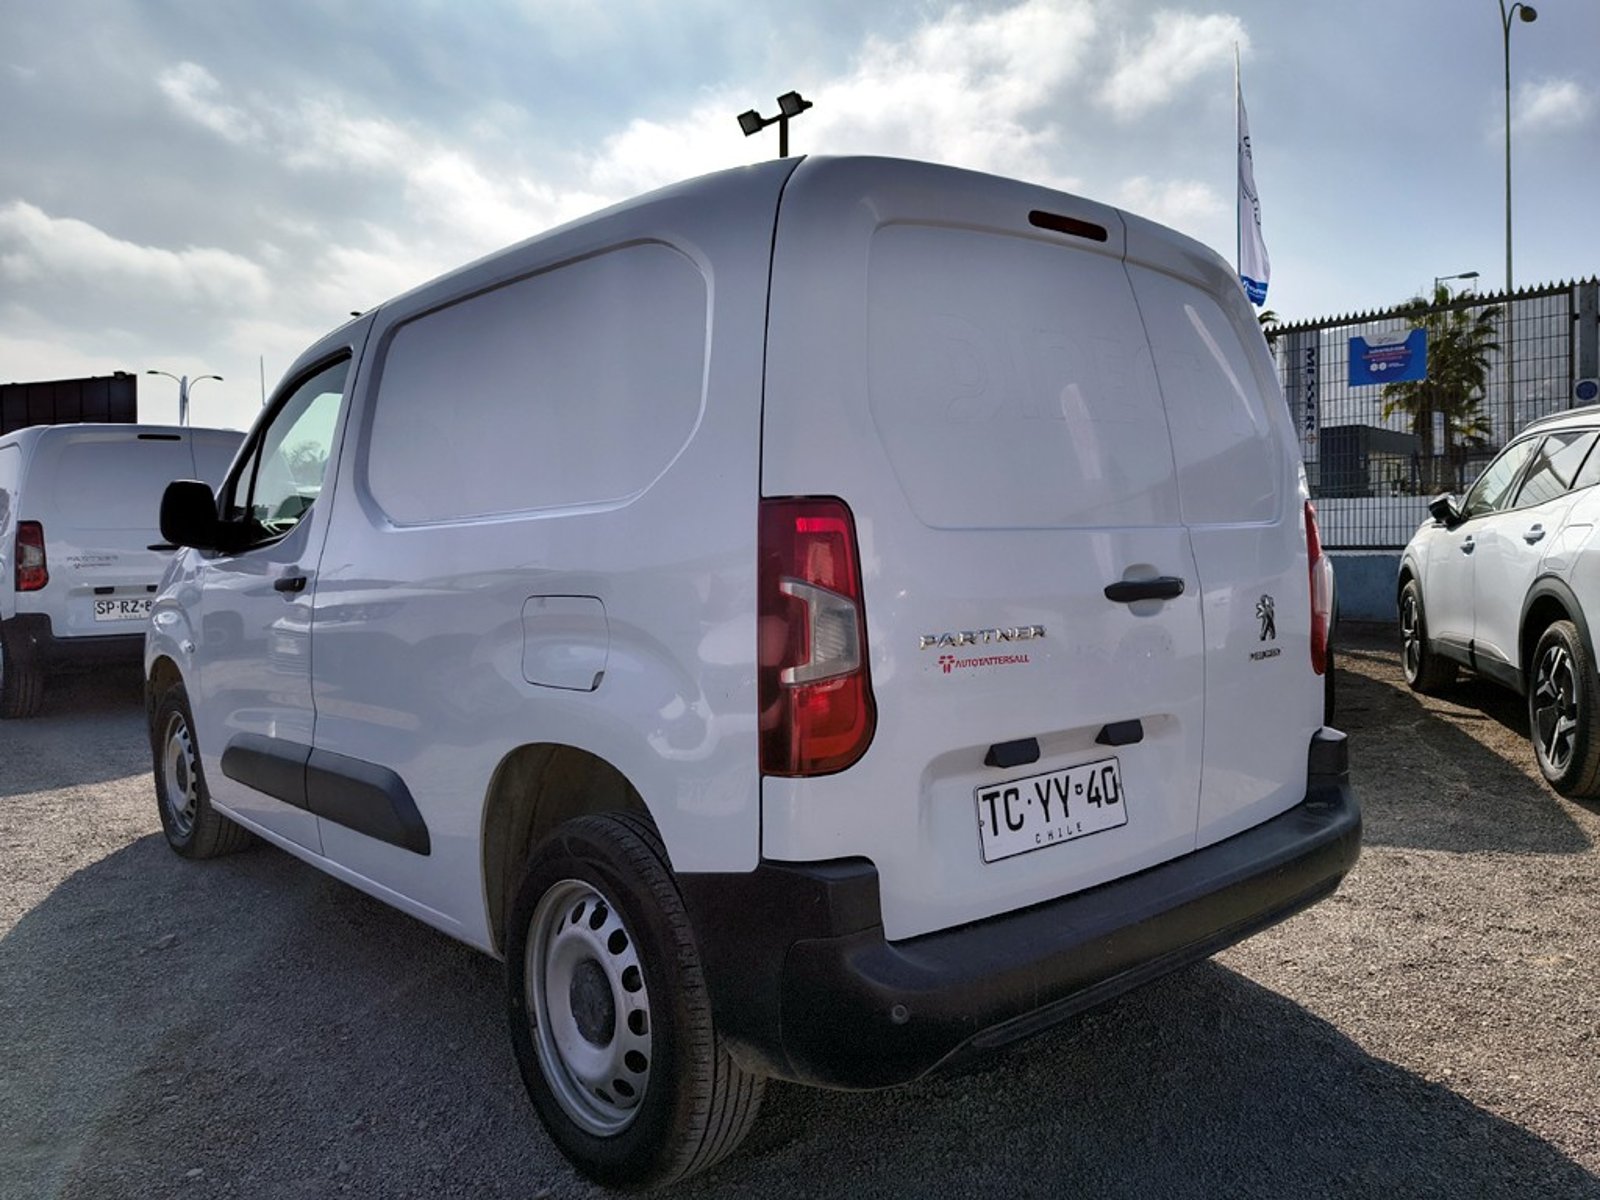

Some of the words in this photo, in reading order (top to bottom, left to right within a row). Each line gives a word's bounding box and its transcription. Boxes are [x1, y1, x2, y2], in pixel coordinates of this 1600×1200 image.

[919, 625, 1046, 650] PARTNER
[955, 654, 1030, 668] AUTOTATTERSALL
[1035, 821, 1083, 844] CHILE
